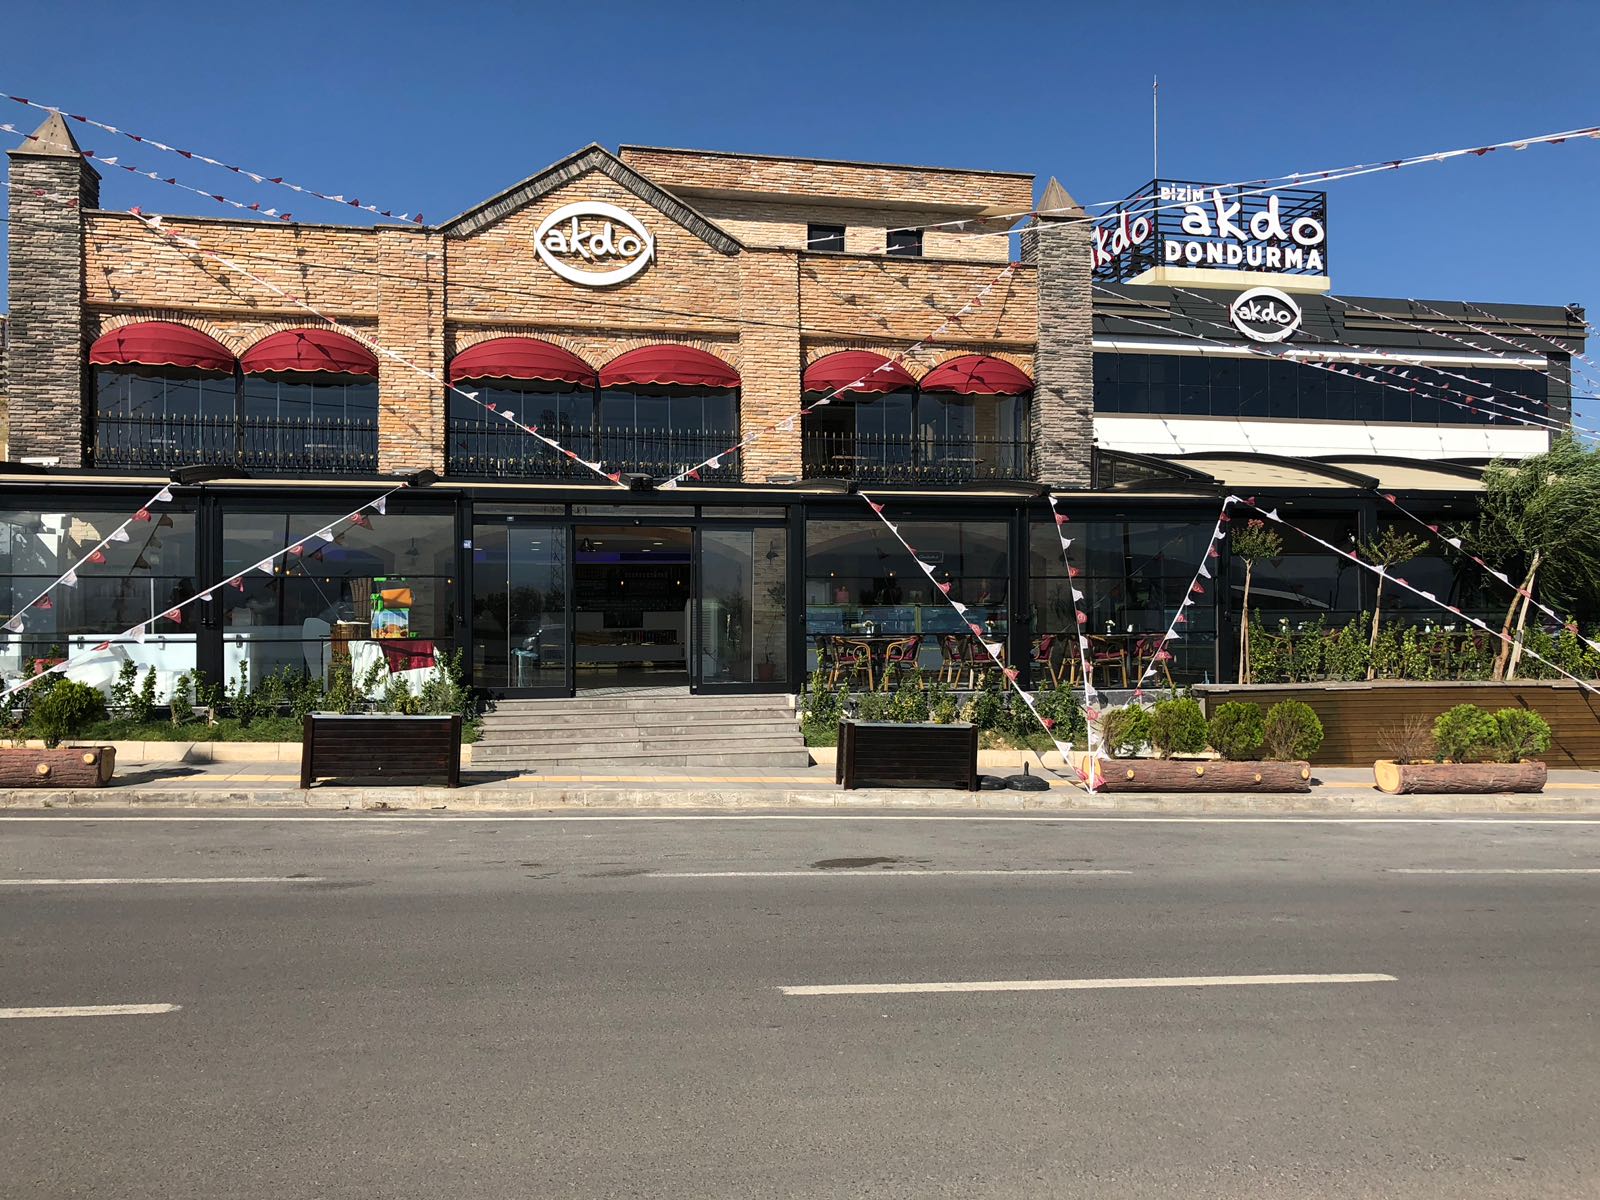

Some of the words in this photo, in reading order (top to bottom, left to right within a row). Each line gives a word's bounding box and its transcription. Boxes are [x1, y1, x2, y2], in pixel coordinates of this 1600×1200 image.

[1182, 189, 1325, 246] akdo
[545, 216, 641, 257] akdo
[1165, 240, 1323, 270] DONDURMA
[1239, 299, 1291, 323] akdo
